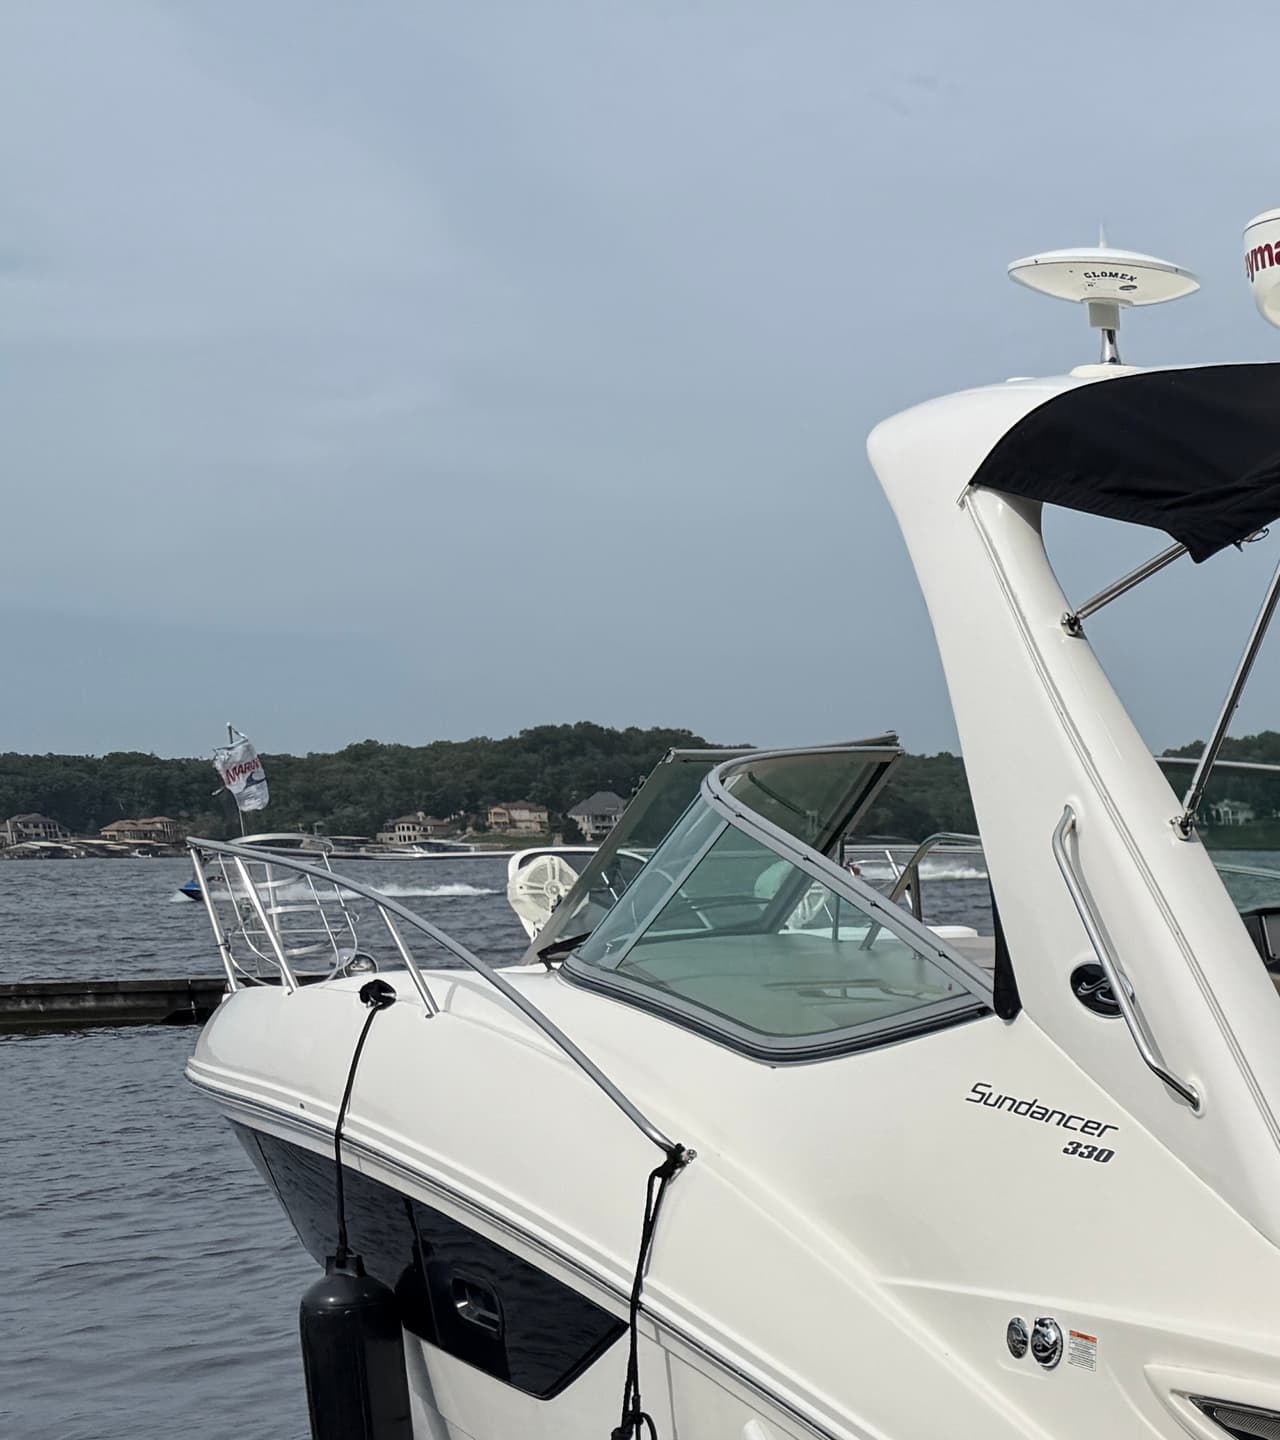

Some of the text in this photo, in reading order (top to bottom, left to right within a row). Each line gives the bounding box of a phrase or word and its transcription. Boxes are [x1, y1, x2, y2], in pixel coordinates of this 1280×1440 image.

[1083, 271, 1137, 282] GLOMEX
[965, 1082, 1120, 1138] Sundancer
[1062, 1141, 1116, 1163] 330
